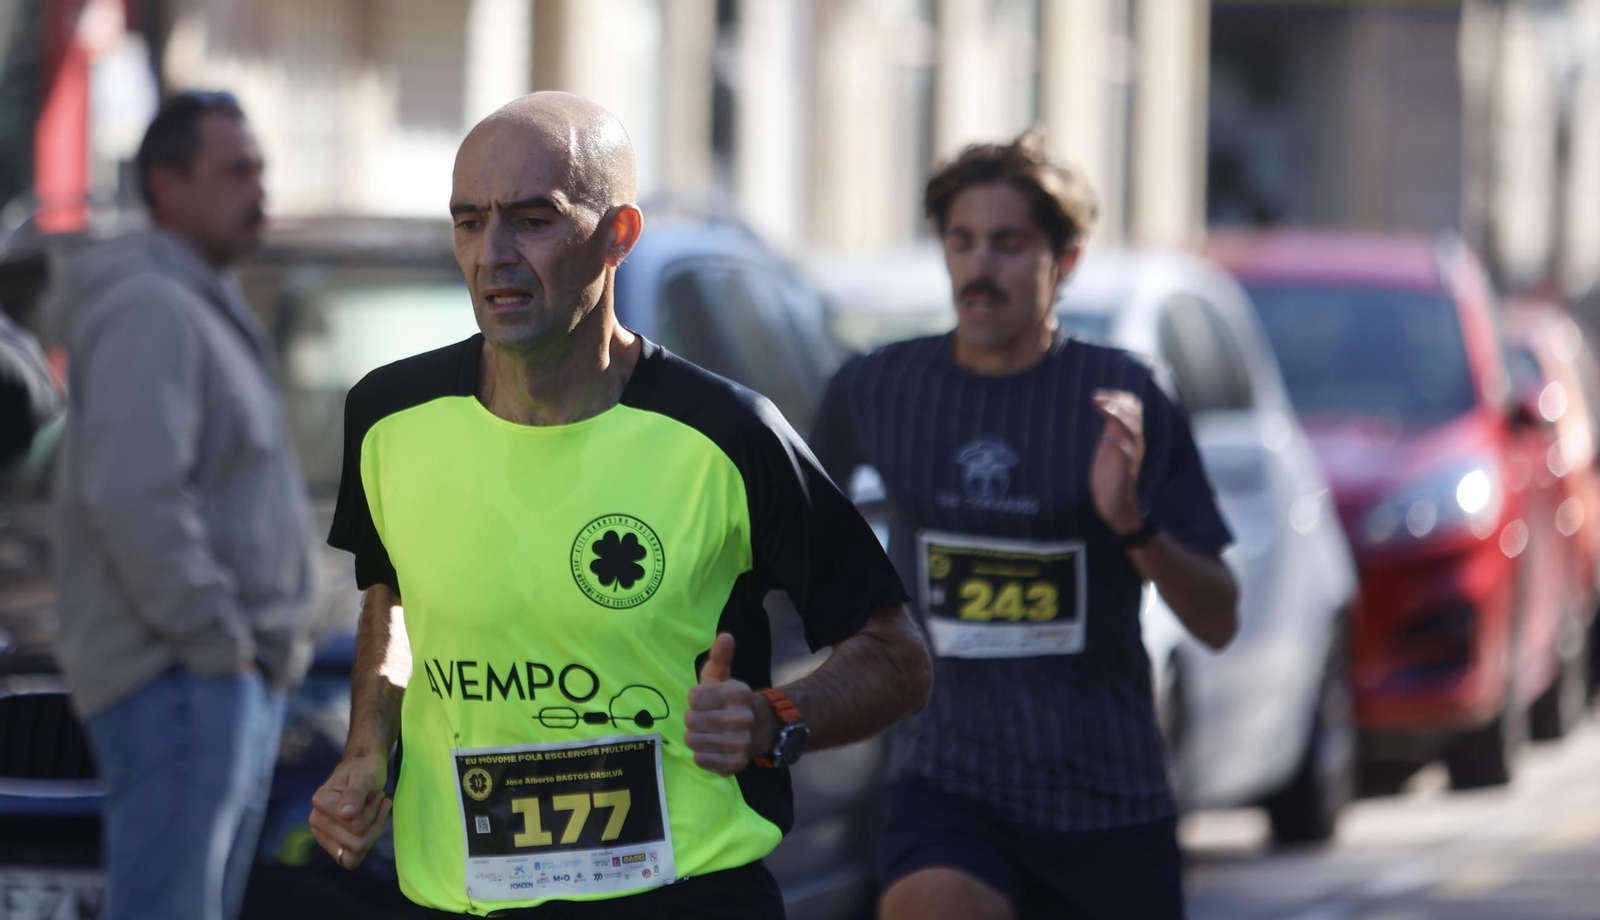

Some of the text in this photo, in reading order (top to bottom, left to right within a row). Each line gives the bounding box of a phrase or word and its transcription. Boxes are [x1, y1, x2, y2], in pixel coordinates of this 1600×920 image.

[587, 517, 629, 534] CARREIRA
[633, 522, 662, 562] SOLIDARIA
[612, 595, 645, 607] ESCLEROSE
[959, 580, 1059, 621] 243
[424, 659, 600, 703] AVEMPO
[518, 754, 543, 762] POLA
[545, 747, 600, 760] ESCLEROSE
[475, 779, 483, 788] 13
[525, 777, 555, 785] Alberto
[556, 772, 589, 782] BASTOS
[590, 769, 623, 779] DASILVA
[511, 789, 631, 848] 177
